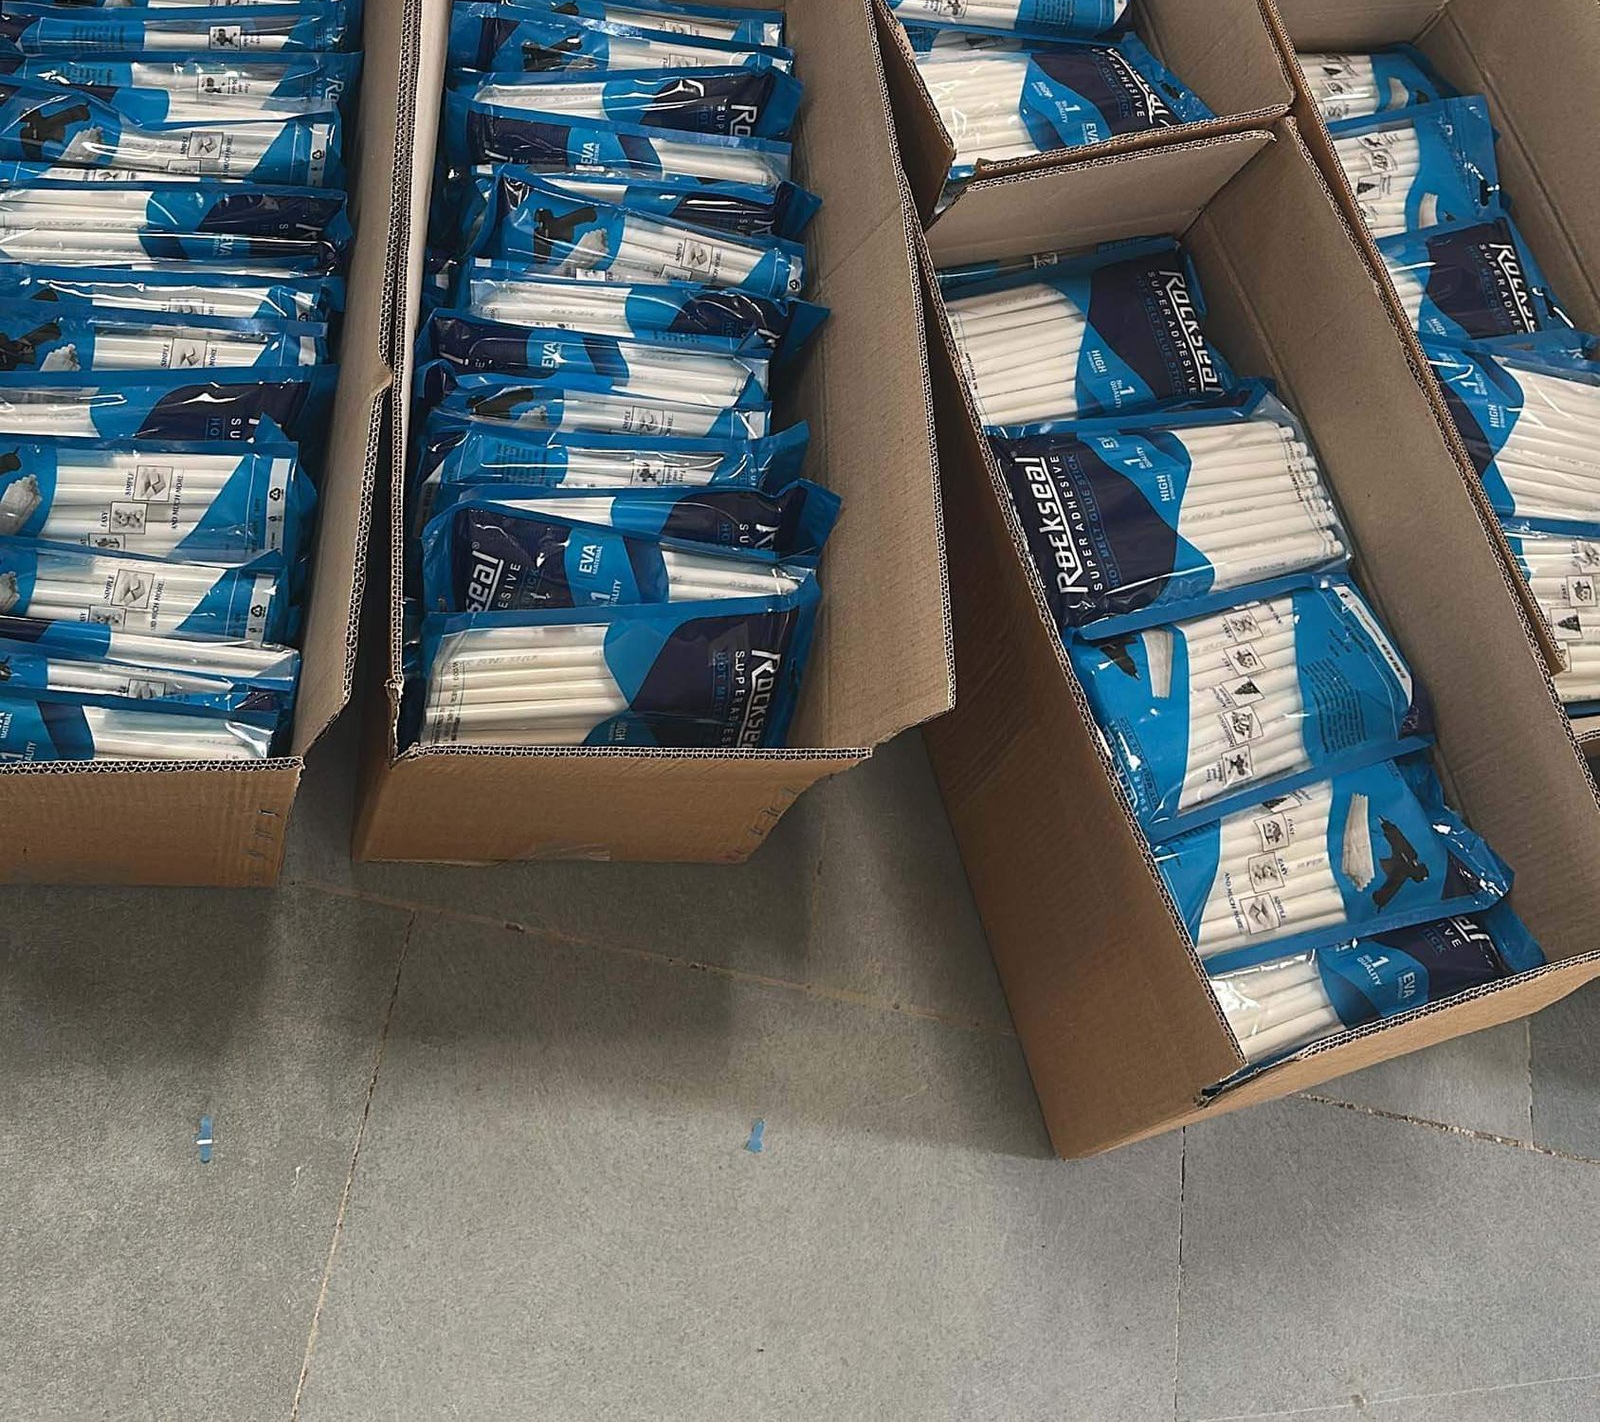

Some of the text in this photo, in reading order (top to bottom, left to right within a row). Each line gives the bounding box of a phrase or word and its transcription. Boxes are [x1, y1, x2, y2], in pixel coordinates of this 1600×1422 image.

[1478, 243, 1525, 335] SUPER ADHES
[1147, 270, 1198, 395] SUPER ADHESIVE
[1091, 349, 1108, 374] HIGH
[1488, 404, 1501, 428] HIGH
[1156, 474, 1170, 502] HIGH
[1050, 455, 1104, 591] SUPER ADHESIVE
[579, 544, 597, 573] EVA
[498, 562, 521, 609] ESIVE
[611, 579, 623, 605] ALITY
[738, 649, 781, 747] Rockse
[1372, 955, 1390, 968] 1
[1403, 971, 1417, 999] EVA
